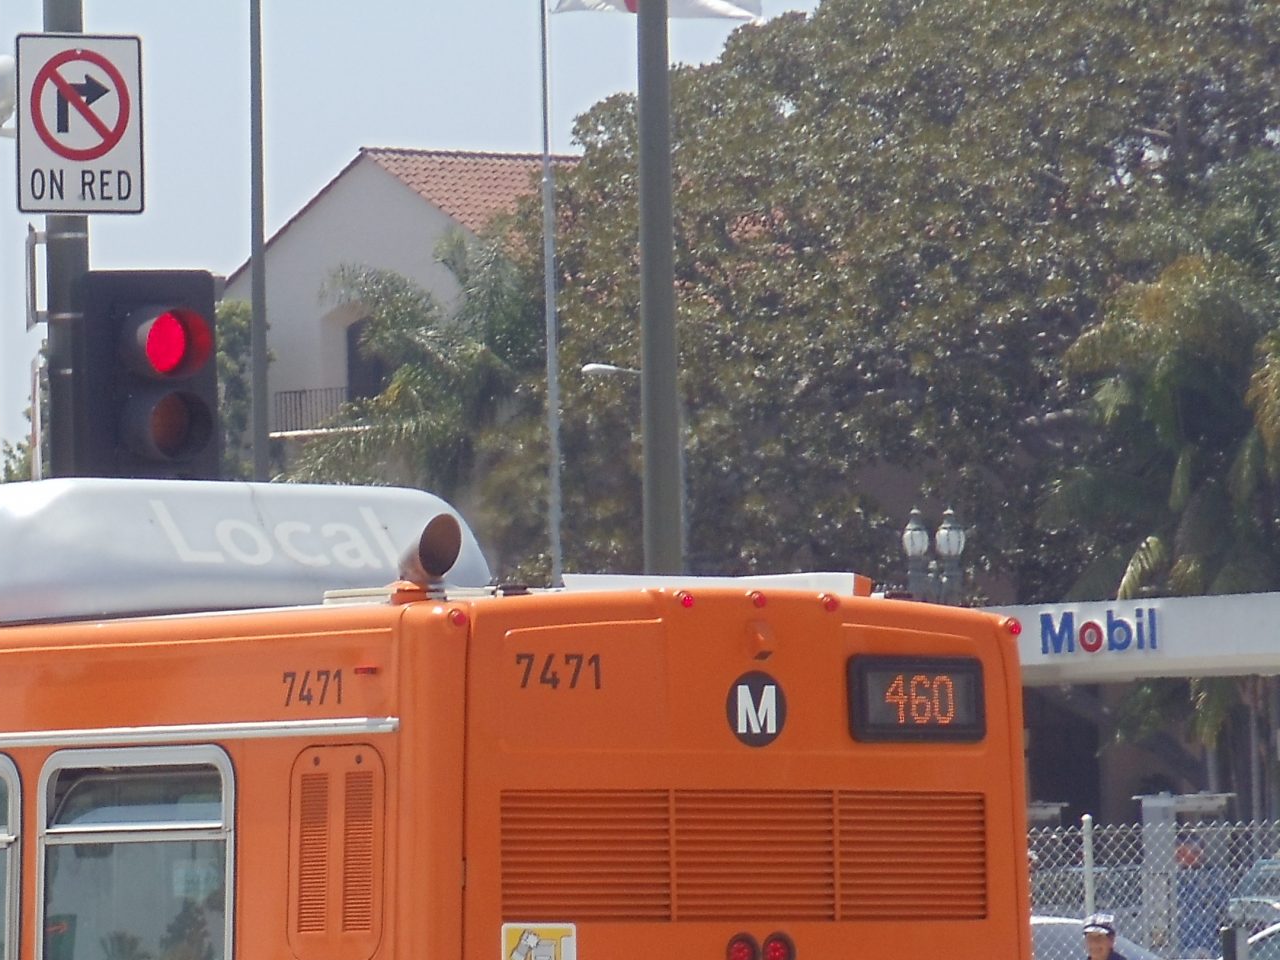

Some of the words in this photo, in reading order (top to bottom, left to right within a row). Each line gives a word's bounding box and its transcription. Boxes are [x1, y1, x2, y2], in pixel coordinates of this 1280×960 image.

[31, 169, 64, 201] ON
[82, 169, 132, 200] RED
[150, 498, 400, 570] Local
[1040, 608, 1159, 654] Mobil
[282, 669, 344, 707] 7471
[515, 653, 602, 690] 7471
[737, 685, 776, 734] M
[885, 674, 954, 724] 460
